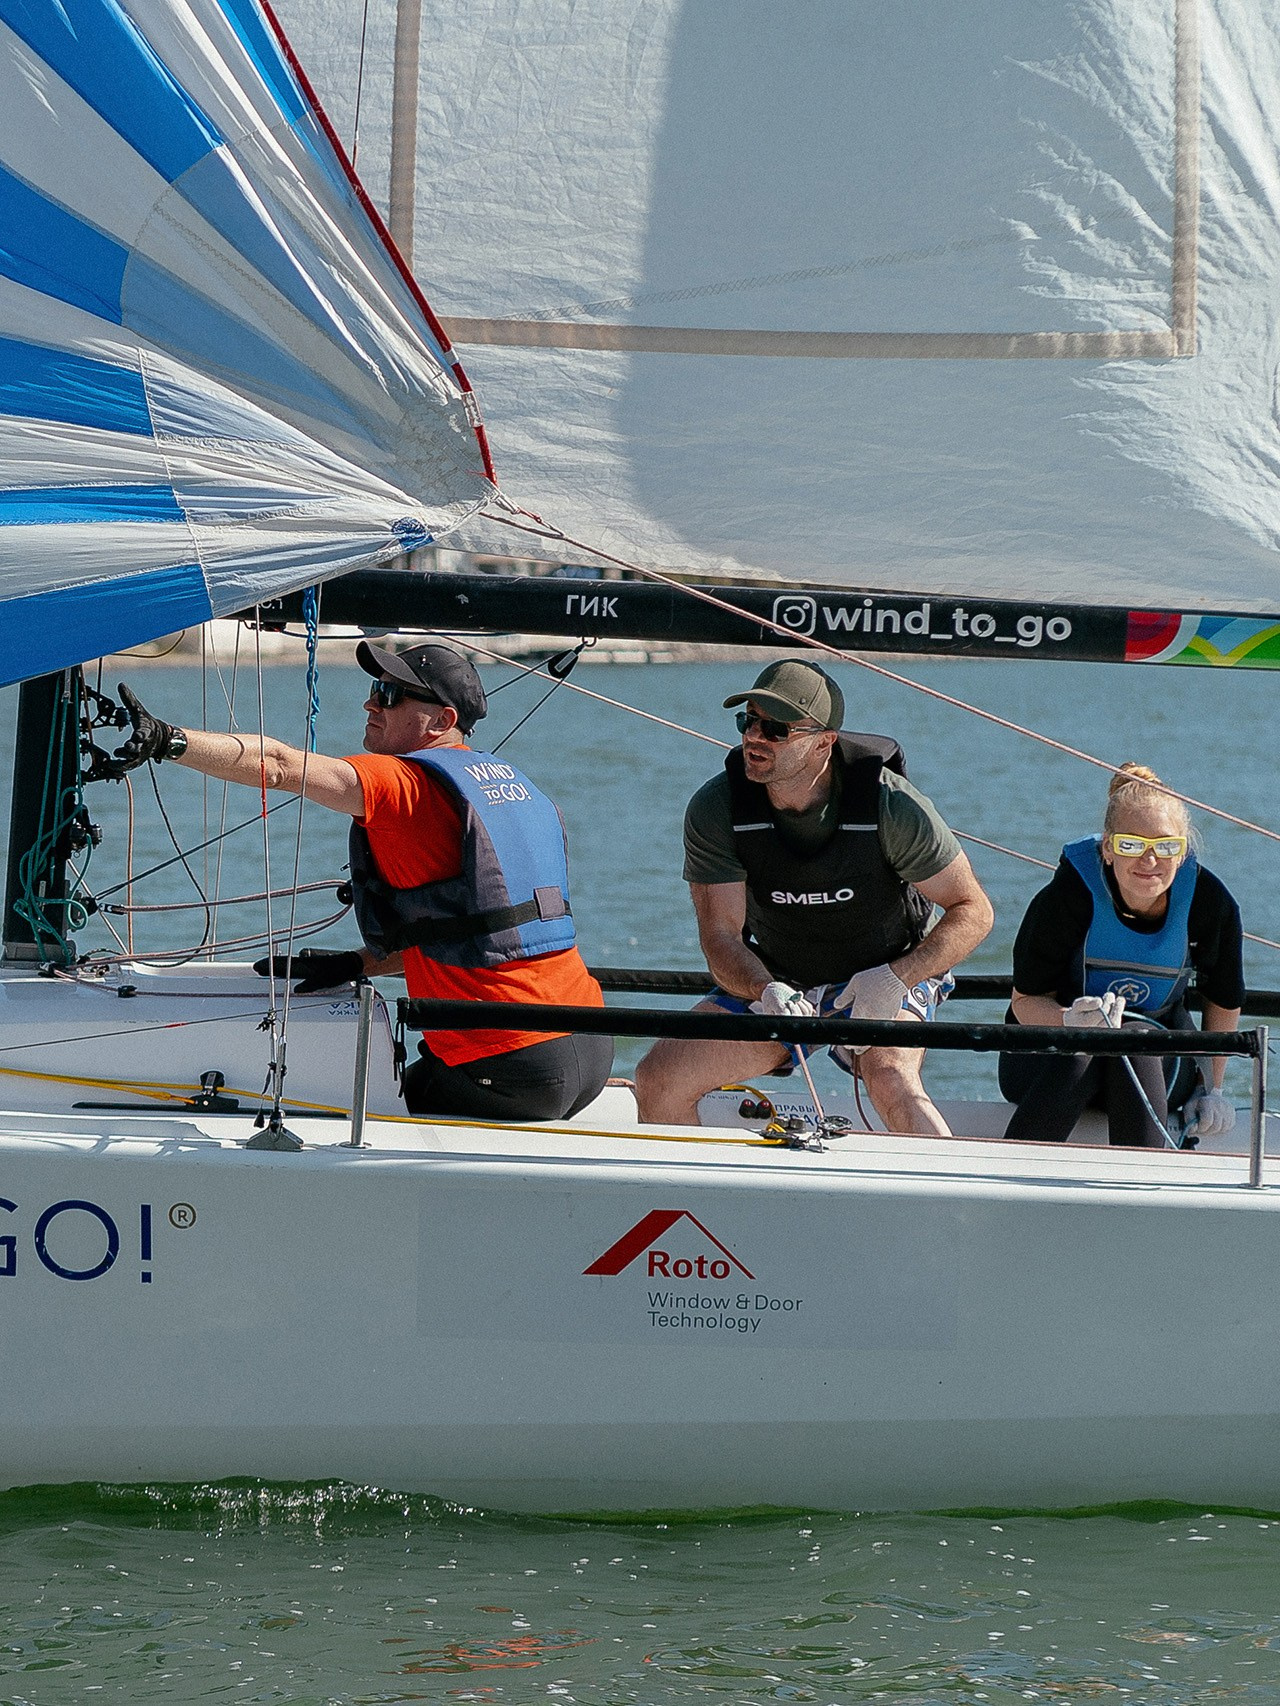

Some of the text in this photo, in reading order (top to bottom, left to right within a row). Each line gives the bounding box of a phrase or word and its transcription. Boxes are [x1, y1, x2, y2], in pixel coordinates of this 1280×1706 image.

[565, 594, 619, 618] ГИК
[822, 597, 1073, 648] wind_to_go
[500, 782, 532, 801] GO!
[770, 887, 855, 905] SMELO
[646, 1250, 732, 1280] Roto
[647, 1291, 804, 1312] Window & Door
[647, 1310, 762, 1334] Technology
